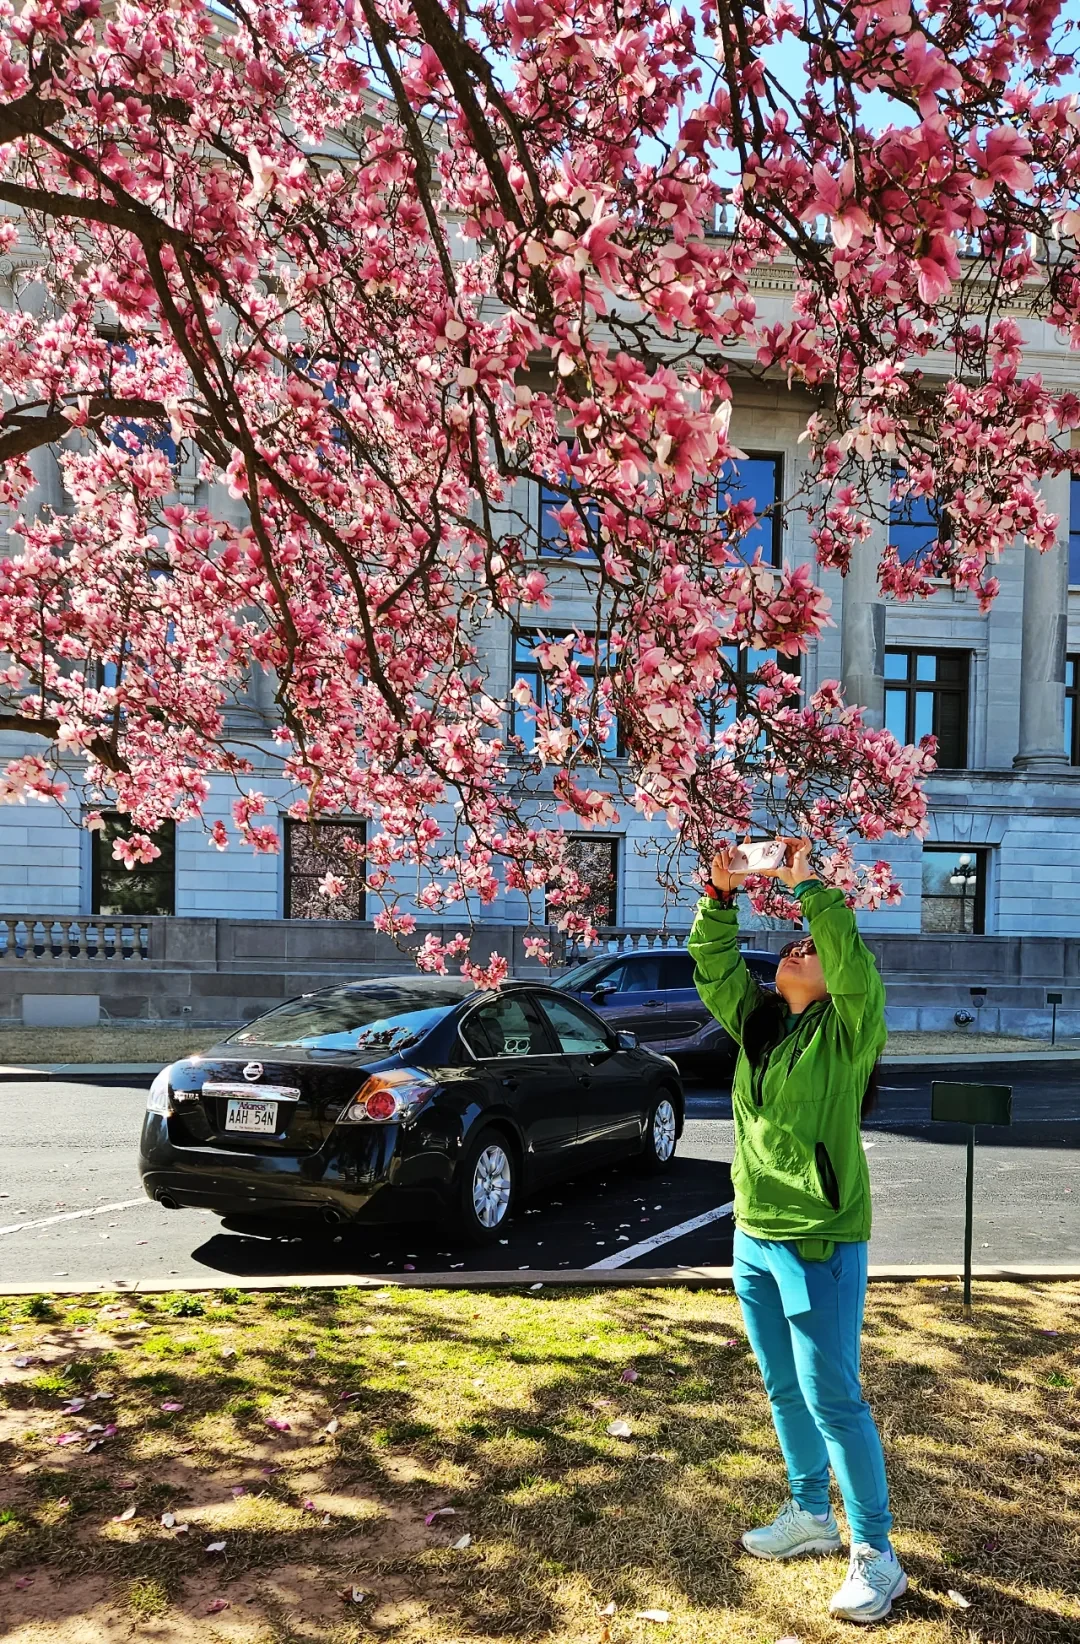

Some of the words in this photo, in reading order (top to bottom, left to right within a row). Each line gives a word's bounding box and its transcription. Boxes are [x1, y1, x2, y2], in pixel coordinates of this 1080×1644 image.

[239, 1102, 266, 1111] Arkansas
[229, 1109, 249, 1124] AAH
[254, 1111, 275, 1126] 54N
